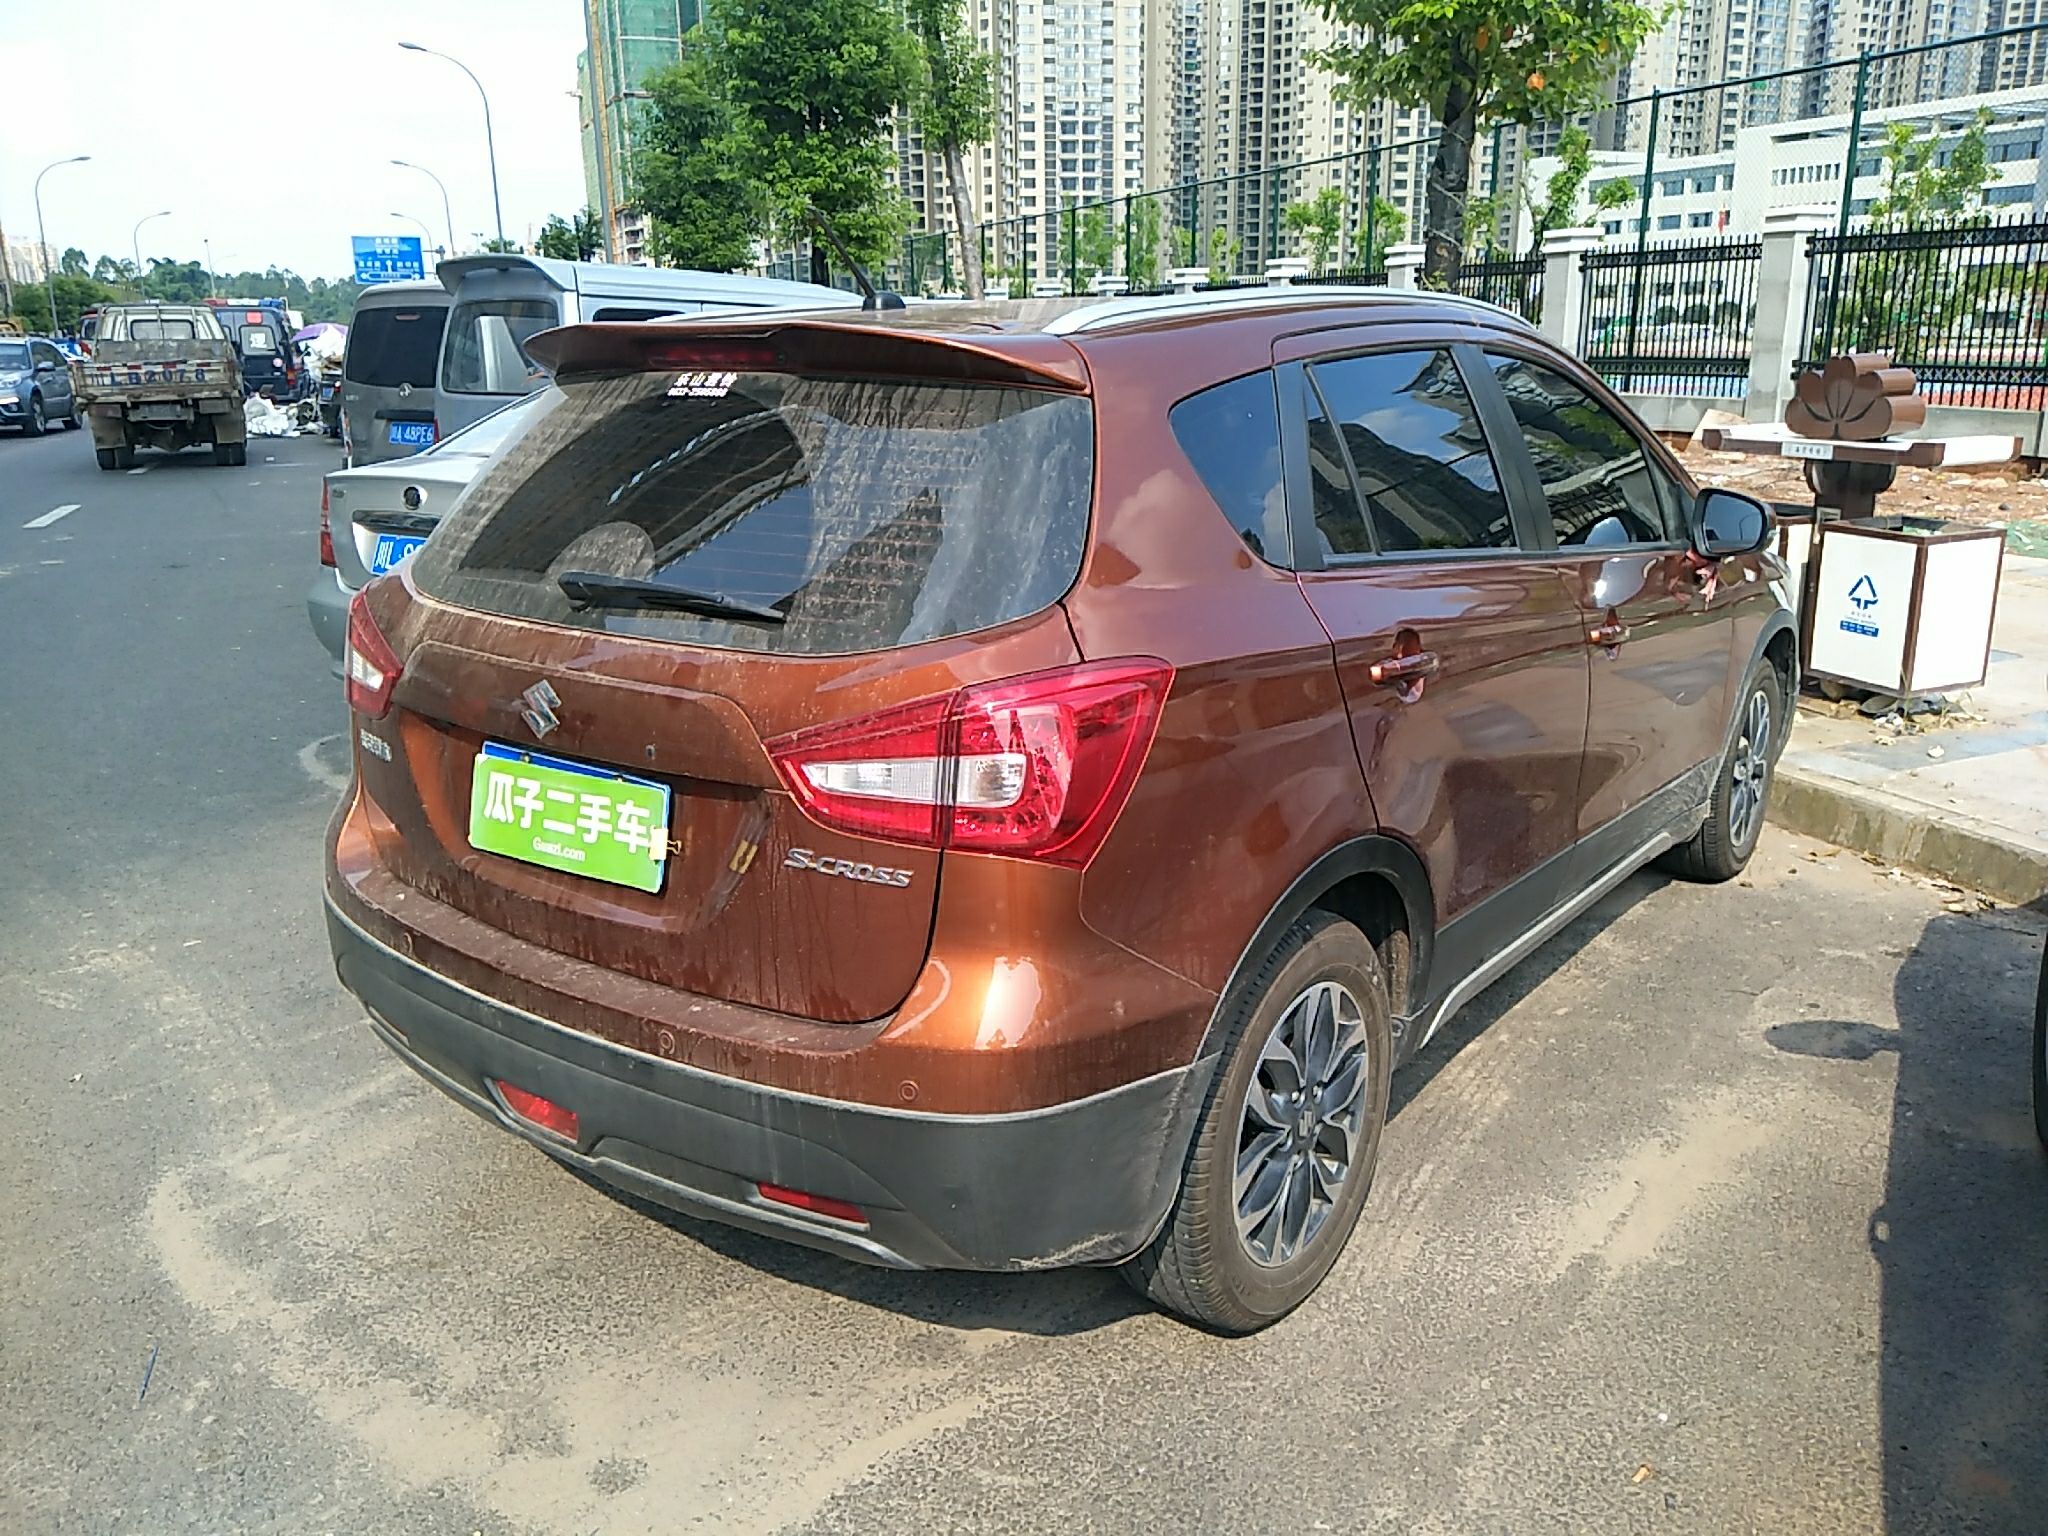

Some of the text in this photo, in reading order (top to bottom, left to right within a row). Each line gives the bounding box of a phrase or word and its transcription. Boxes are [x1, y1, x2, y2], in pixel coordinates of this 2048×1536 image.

[484, 771, 651, 854] 瓜子二手车
